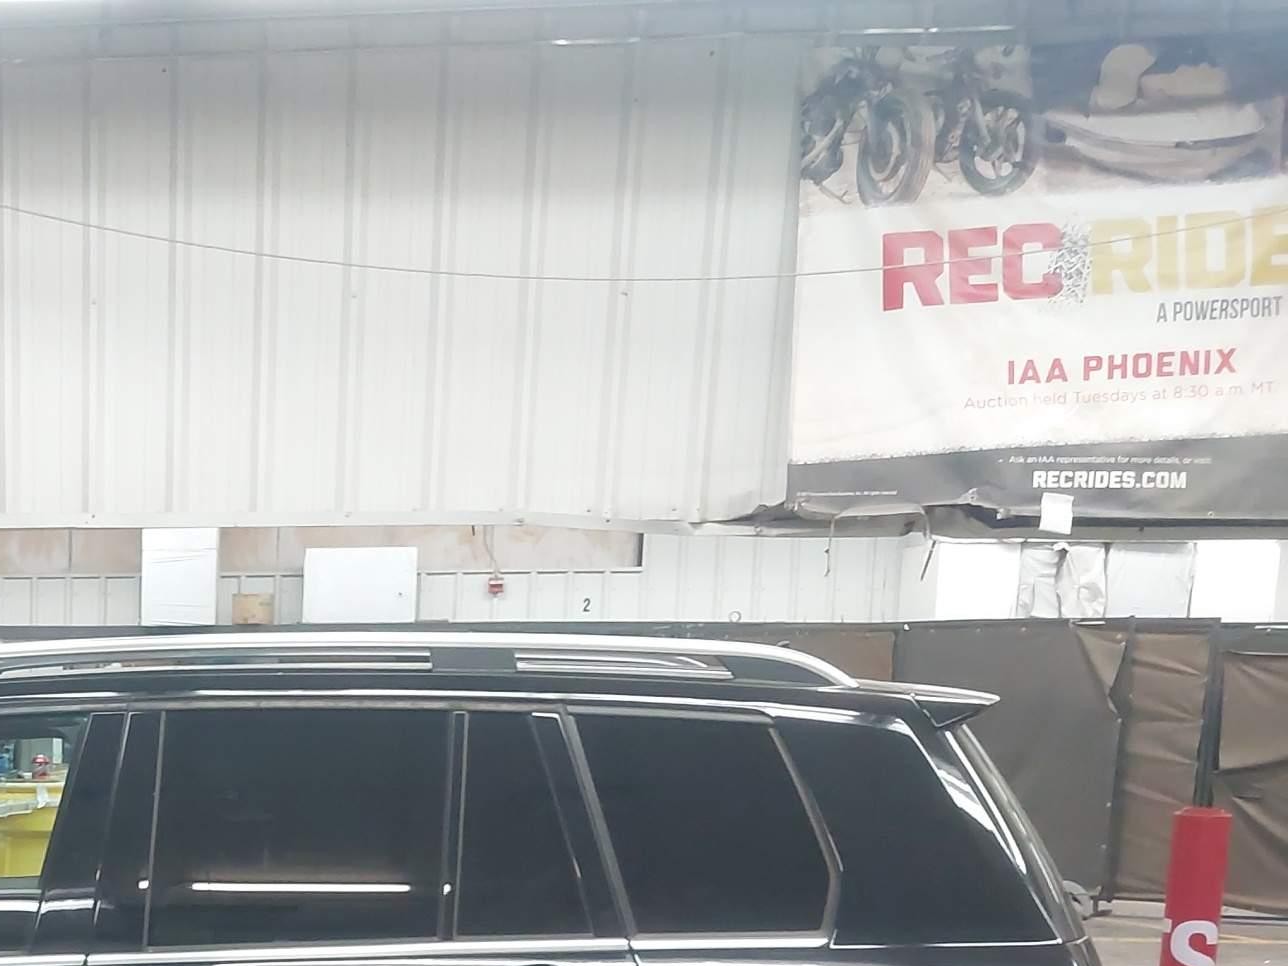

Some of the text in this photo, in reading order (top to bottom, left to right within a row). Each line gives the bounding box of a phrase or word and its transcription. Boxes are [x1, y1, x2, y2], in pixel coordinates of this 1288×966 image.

[882, 206, 1288, 312] REC RIDE
[1156, 295, 1283, 322] A POWERSPORT
[1008, 348, 1237, 385] IAA PHOENIX
[964, 395, 1028, 410] Auction
[1033, 391, 1068, 405] held
[1073, 386, 1146, 405] Tuesdays
[1152, 387, 1168, 400] at
[1173, 383, 1209, 399] 8:30
[1039, 455, 1055, 464] IAA
[1032, 470, 1187, 489] RECRIDES.COM
[582, 598, 591, 612] 2
